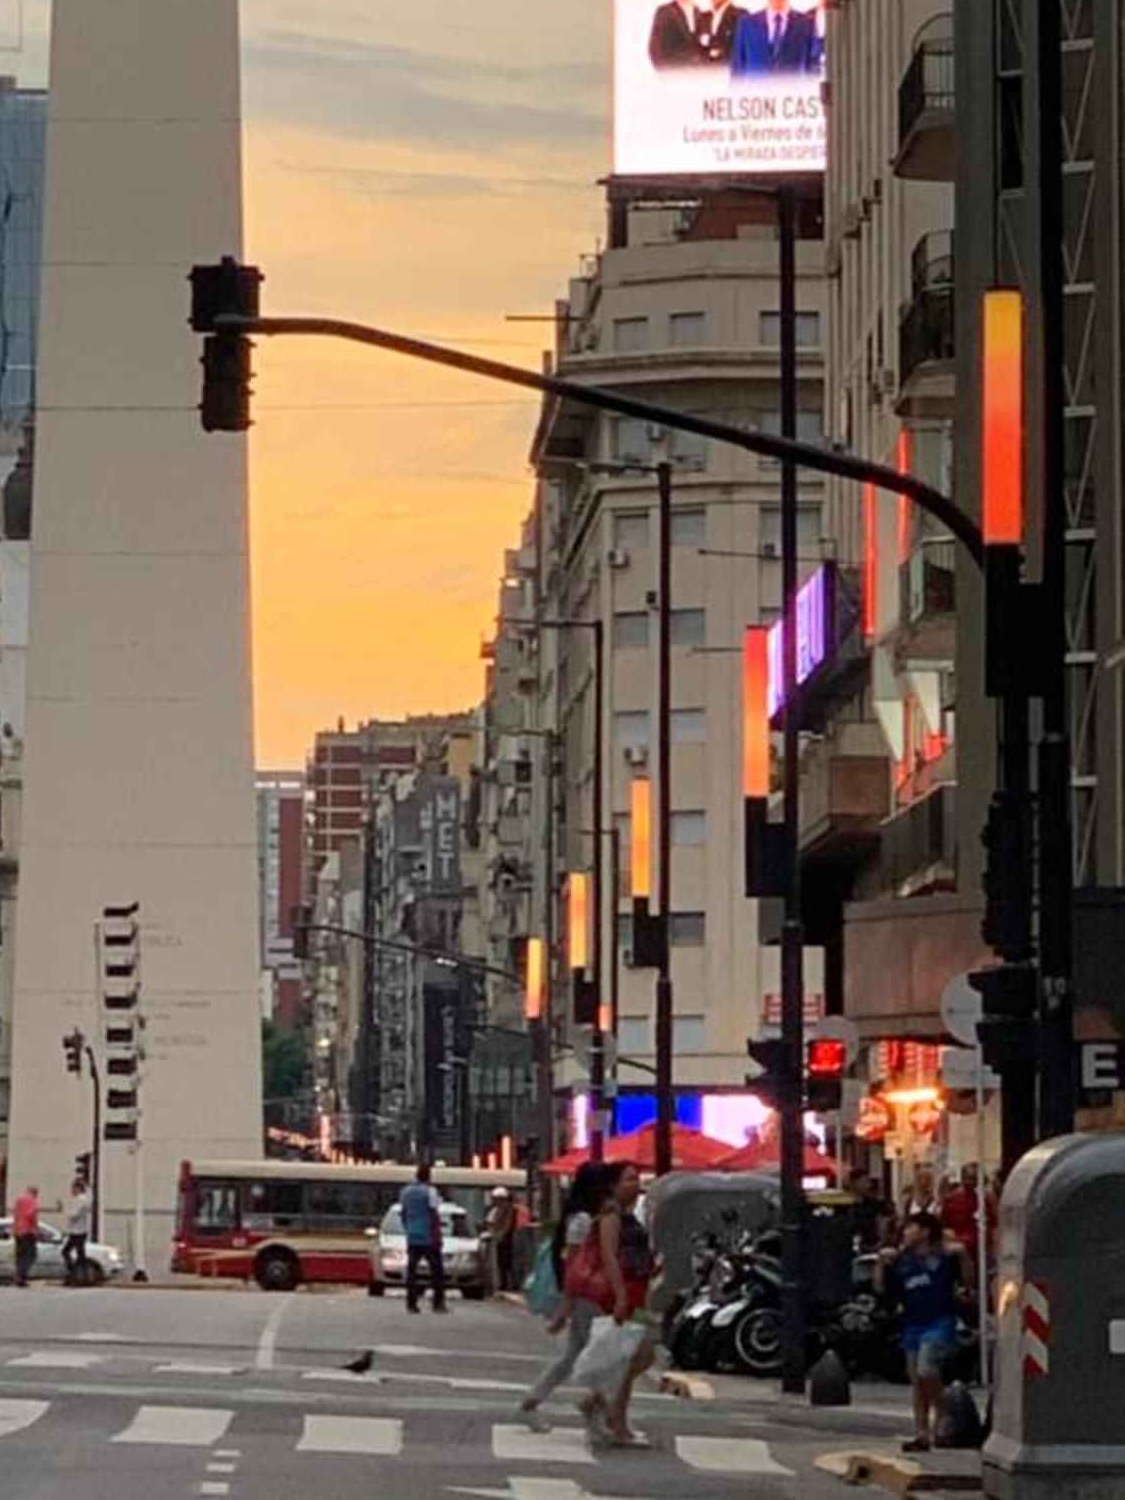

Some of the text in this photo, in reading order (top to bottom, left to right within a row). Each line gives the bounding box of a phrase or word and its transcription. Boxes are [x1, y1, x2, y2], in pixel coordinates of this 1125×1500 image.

[702, 96, 776, 121] NELSON
[683, 126, 724, 143] Lunes
[729, 129, 737, 142] a
[740, 124, 791, 141] Viernes
[796, 124, 812, 140] de
